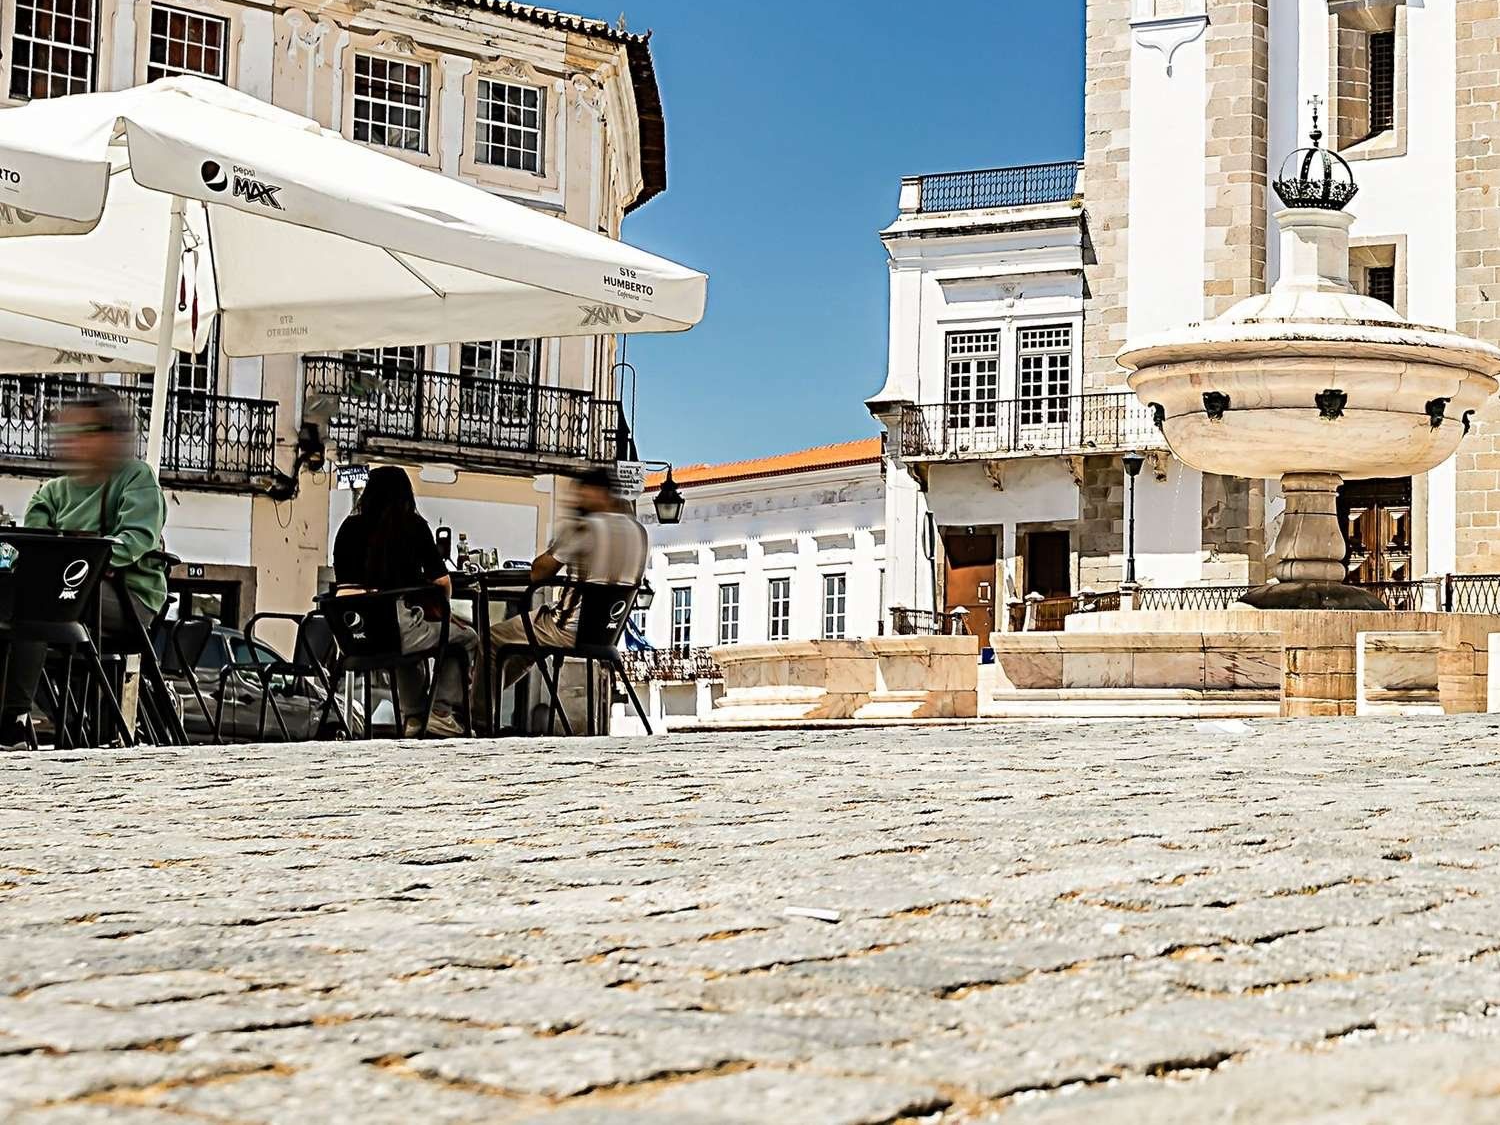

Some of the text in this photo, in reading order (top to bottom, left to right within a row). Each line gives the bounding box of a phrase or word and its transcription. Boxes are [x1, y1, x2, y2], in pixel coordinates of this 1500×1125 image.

[232, 165, 256, 177] pepsi
[232, 175, 282, 210] MAX
[603, 275, 653, 296] HUMBERTO
[189, 566, 203, 577] 90
